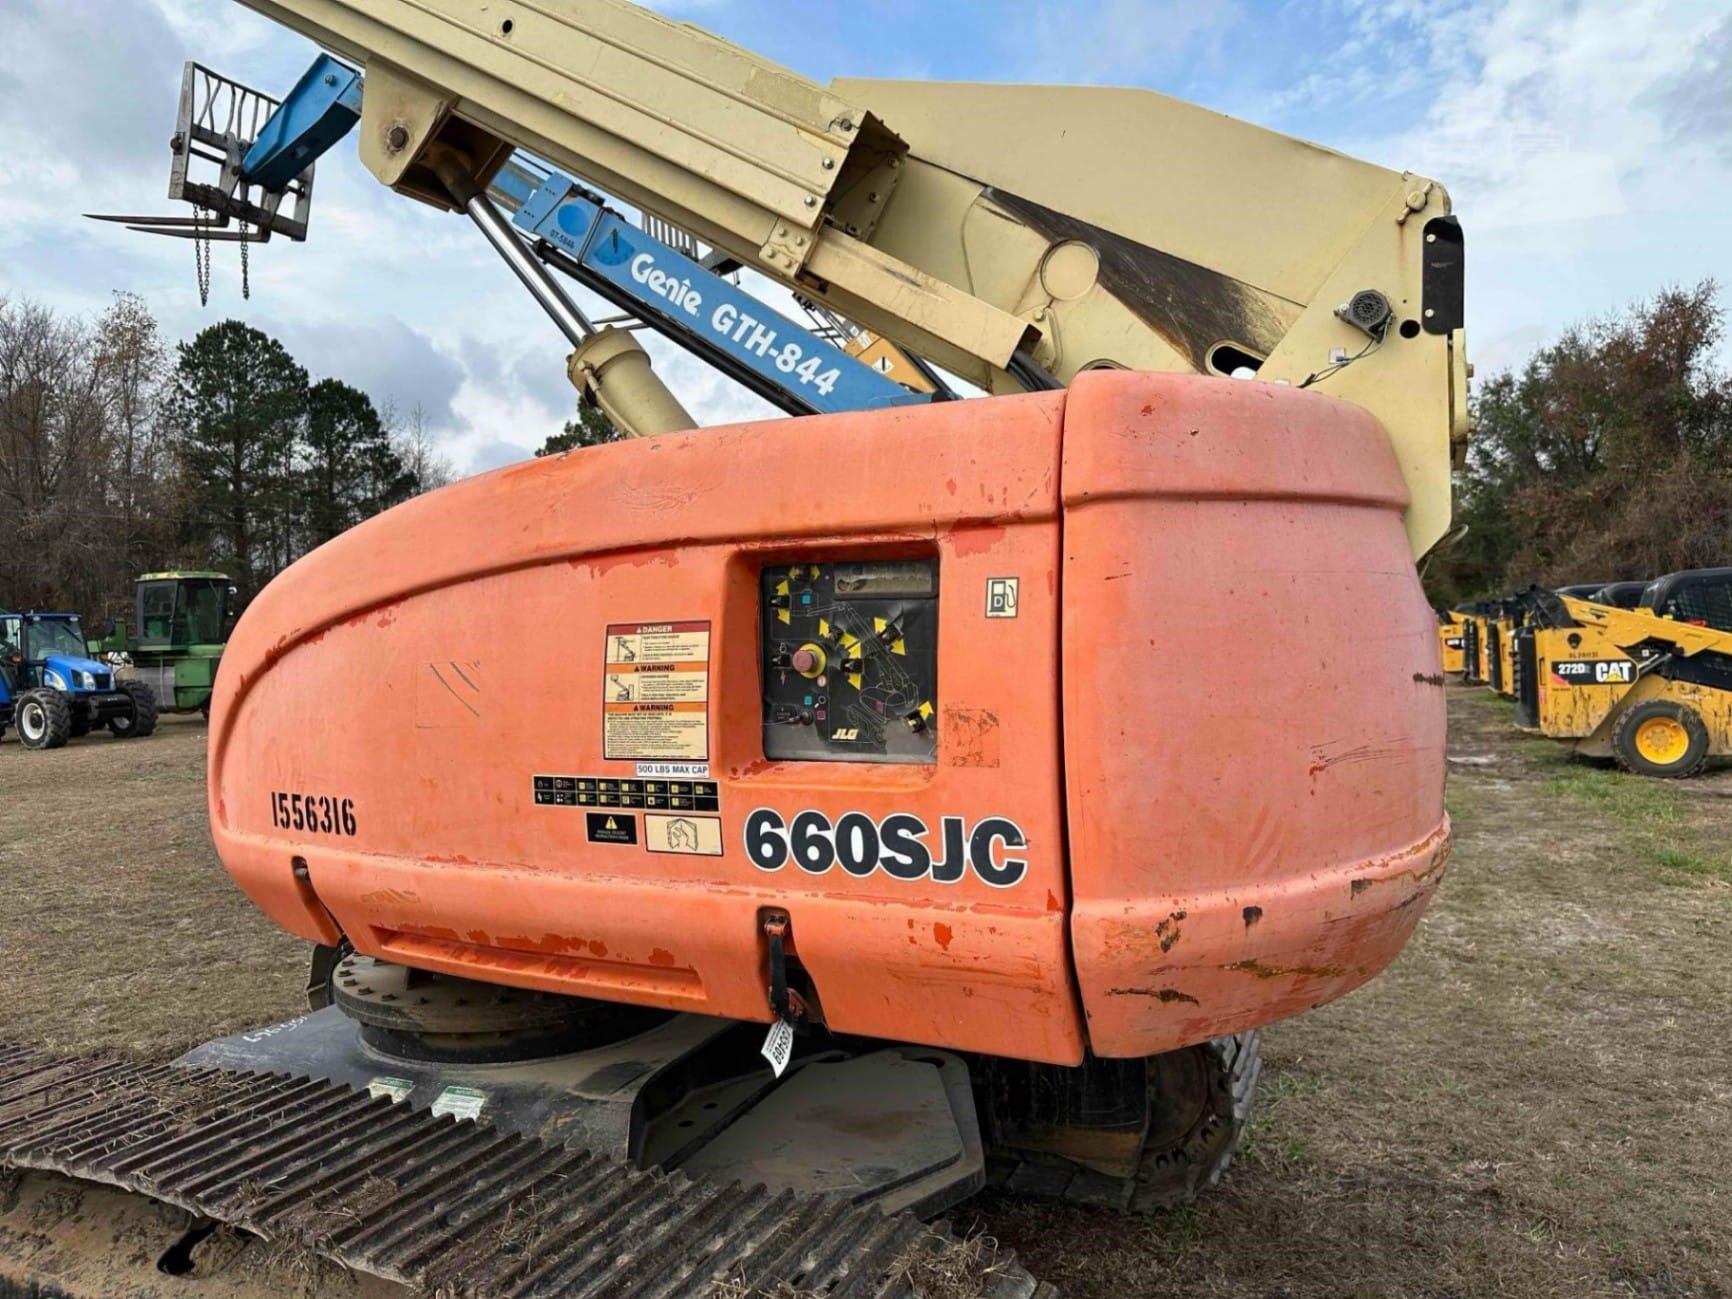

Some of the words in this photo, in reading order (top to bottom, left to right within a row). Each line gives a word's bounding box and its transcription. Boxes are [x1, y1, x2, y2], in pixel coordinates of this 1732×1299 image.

[631, 253, 702, 316] Genie
[711, 303, 841, 396] GTH-844
[994, 596, 1004, 607] D
[642, 625, 673, 633] DANGER
[640, 664, 675, 672] WARNING
[1595, 662, 1632, 682] CAT
[639, 704, 674, 712] WARNING
[831, 728, 859, 740] JLG
[638, 765, 653, 774] 500
[655, 765, 671, 774] LBS
[672, 765, 690, 774] MAX
[691, 766, 708, 774] CAP
[271, 791, 357, 837] 1556316
[743, 807, 1028, 889] 660SJC
